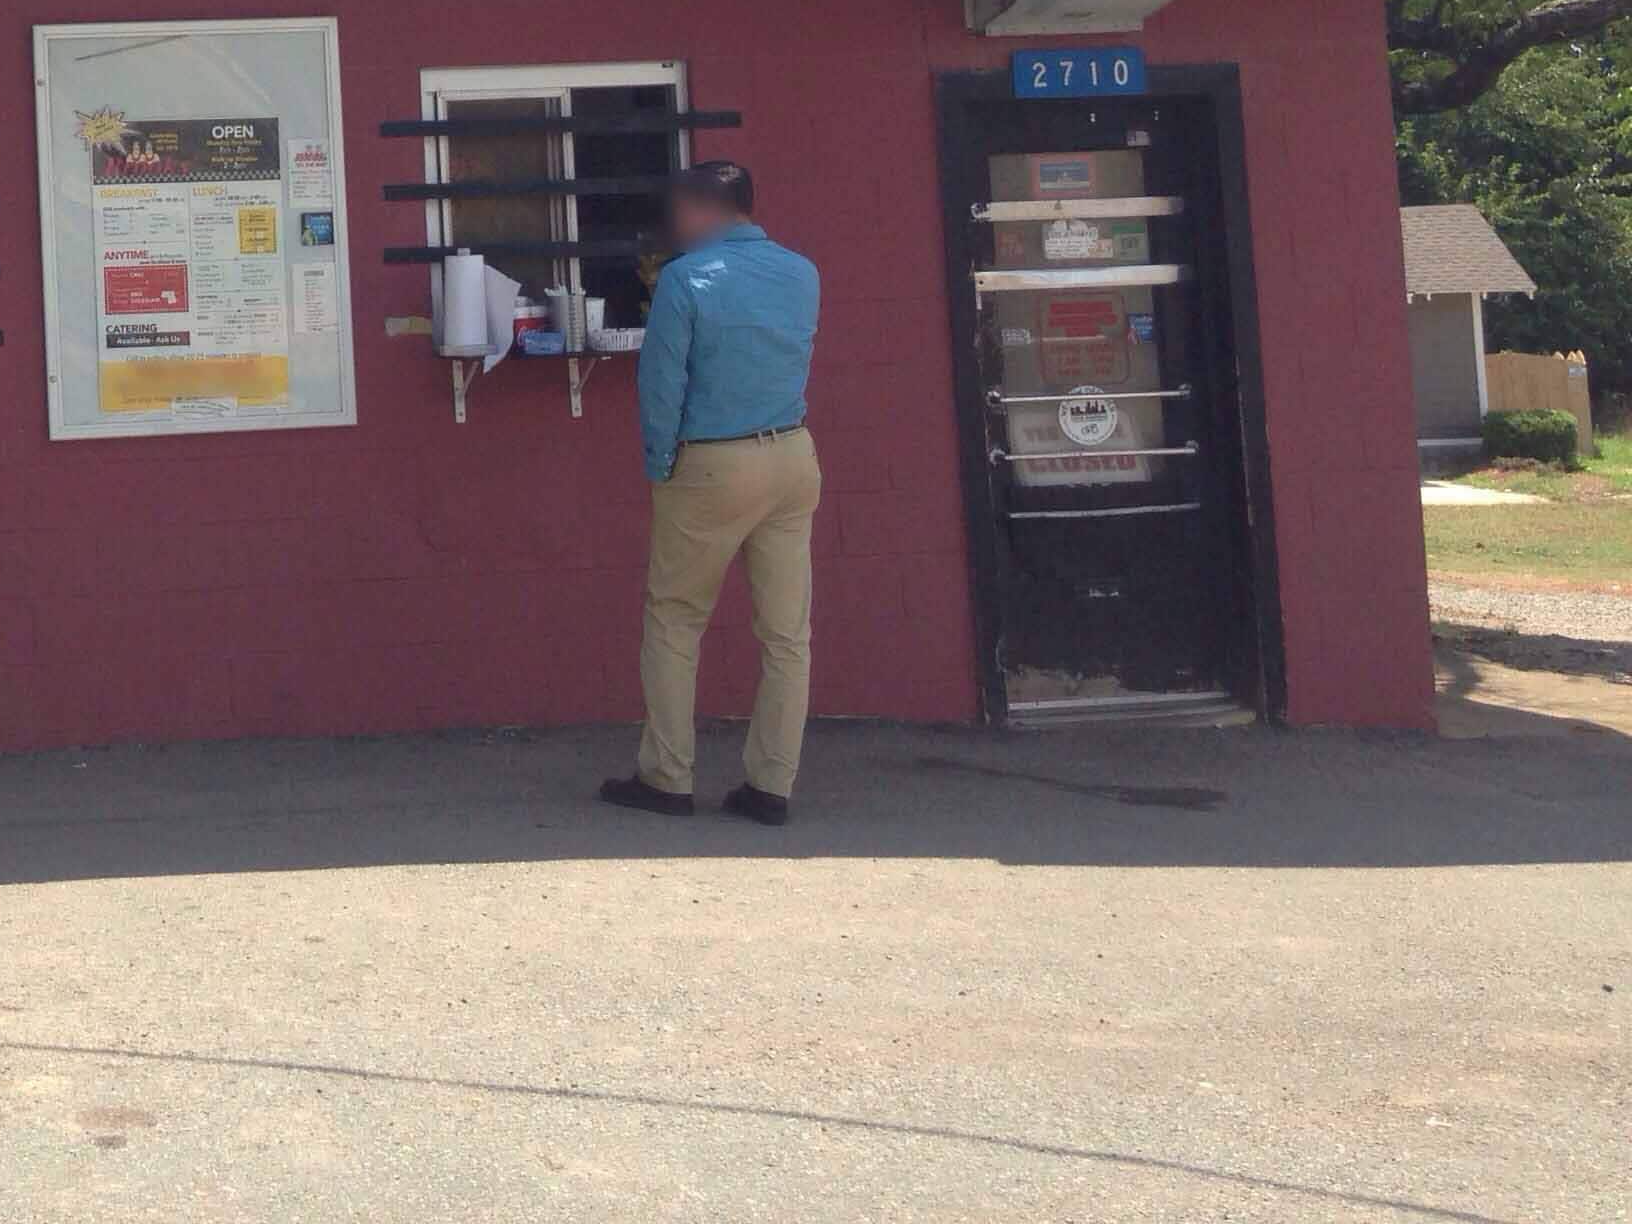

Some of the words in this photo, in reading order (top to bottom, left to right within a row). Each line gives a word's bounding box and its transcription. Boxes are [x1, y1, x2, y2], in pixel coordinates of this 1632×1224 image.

[1032, 59, 1129, 88] 2710
[211, 124, 254, 139] OPEN
[104, 249, 152, 261] ANYTIME
[105, 323, 158, 334] CATERING
